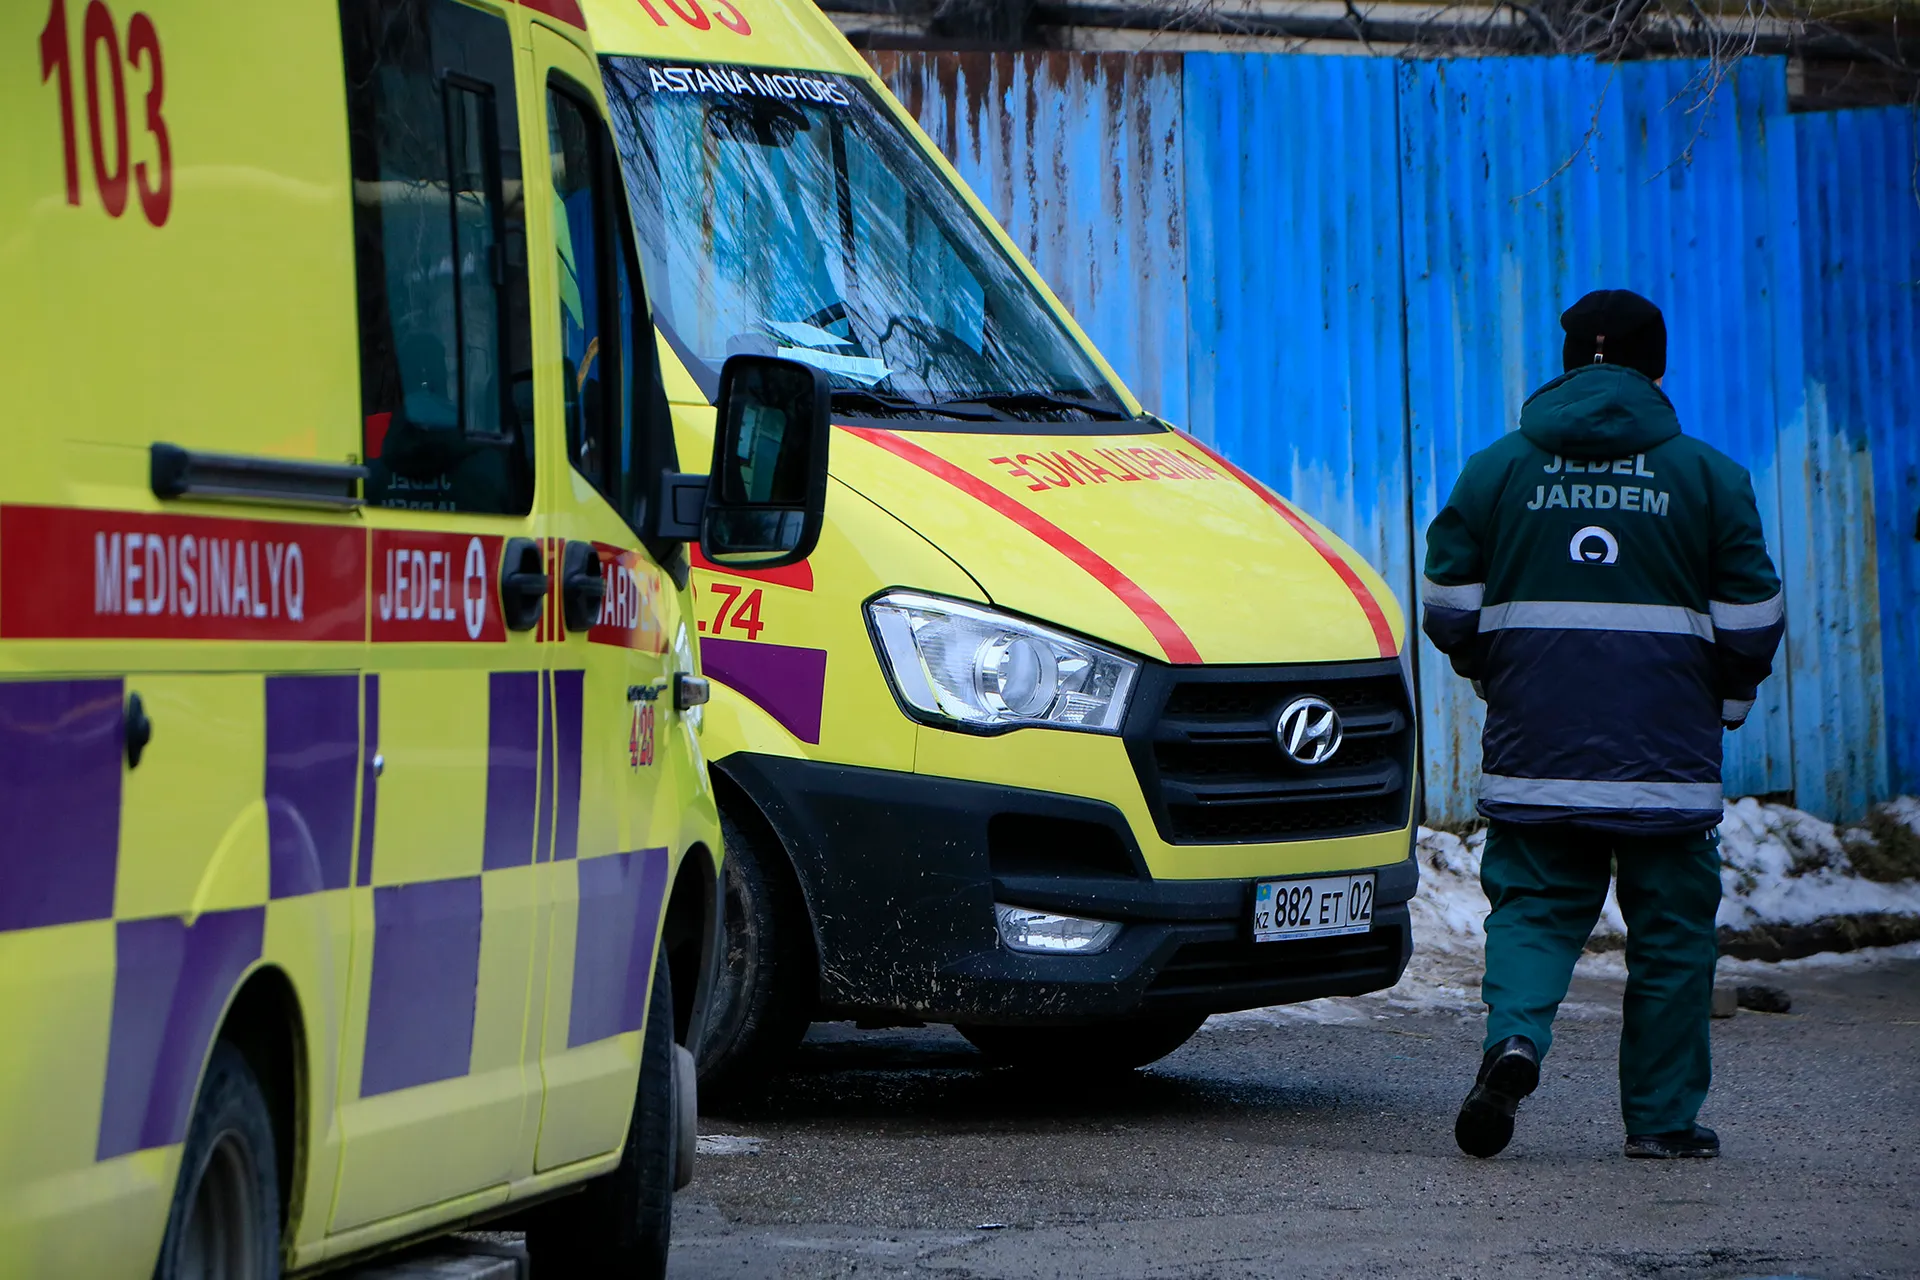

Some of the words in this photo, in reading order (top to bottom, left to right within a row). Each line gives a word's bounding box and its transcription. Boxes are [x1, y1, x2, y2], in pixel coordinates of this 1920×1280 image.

[38, 0, 172, 228] 103
[649, 67, 755, 97] ASTANA
[750, 73, 849, 106] MOTORS
[94, 531, 304, 622] MEDISINALYQ
[379, 549, 457, 621] JEDEL
[596, 562, 660, 632] ARDE
[692, 581, 764, 640] .74
[1255, 912, 1270, 929] KZ
[1275, 885, 1313, 928] 882
[1319, 891, 1344, 925] ET
[1350, 880, 1373, 921] 02
